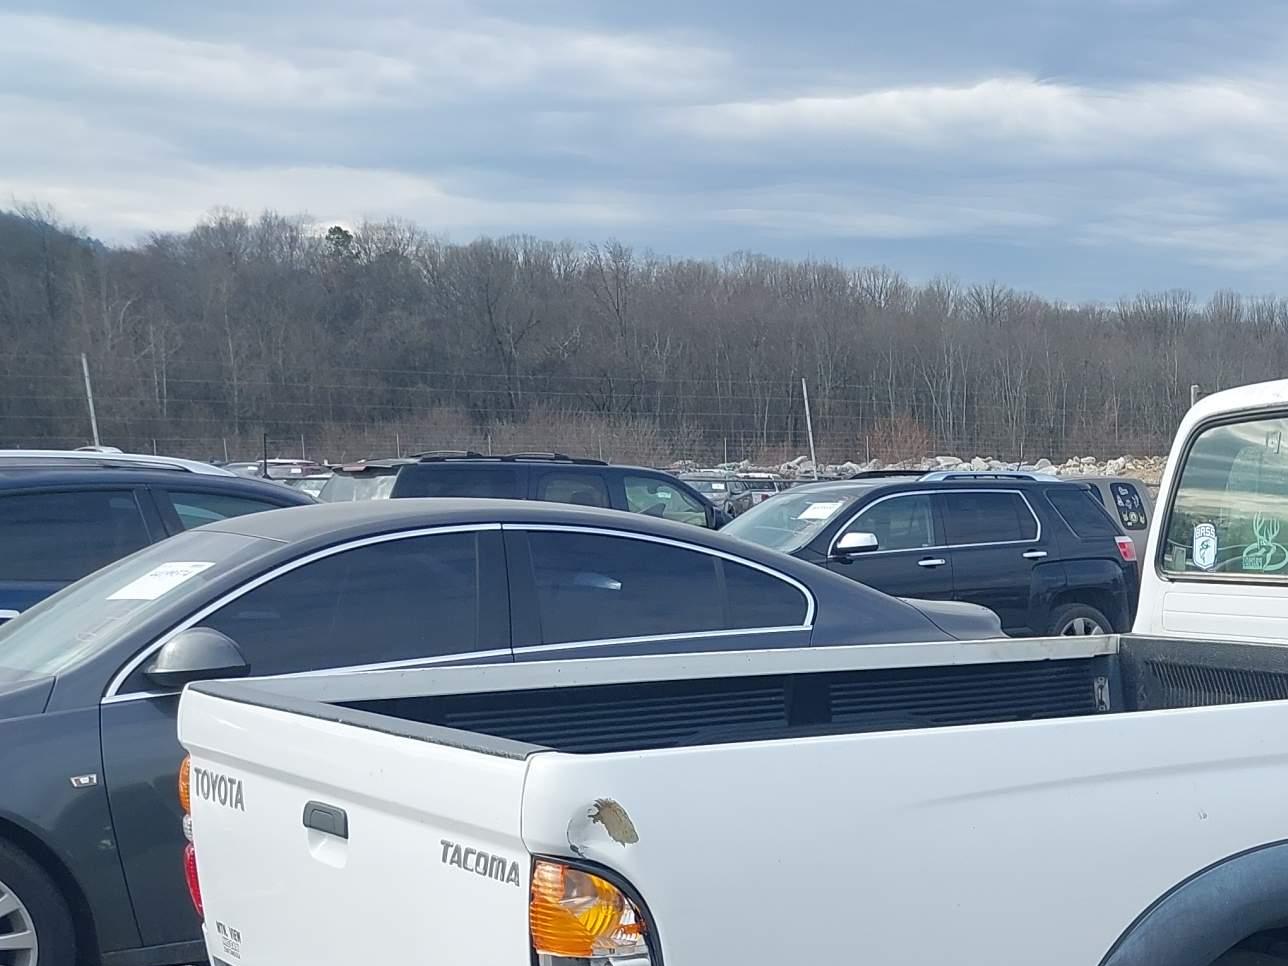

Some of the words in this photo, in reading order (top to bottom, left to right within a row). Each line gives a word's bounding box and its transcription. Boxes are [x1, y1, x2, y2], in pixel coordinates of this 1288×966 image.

[1195, 526, 1216, 538] BASS
[194, 767, 245, 811] TOYOTA
[440, 839, 520, 887] TACOMA
